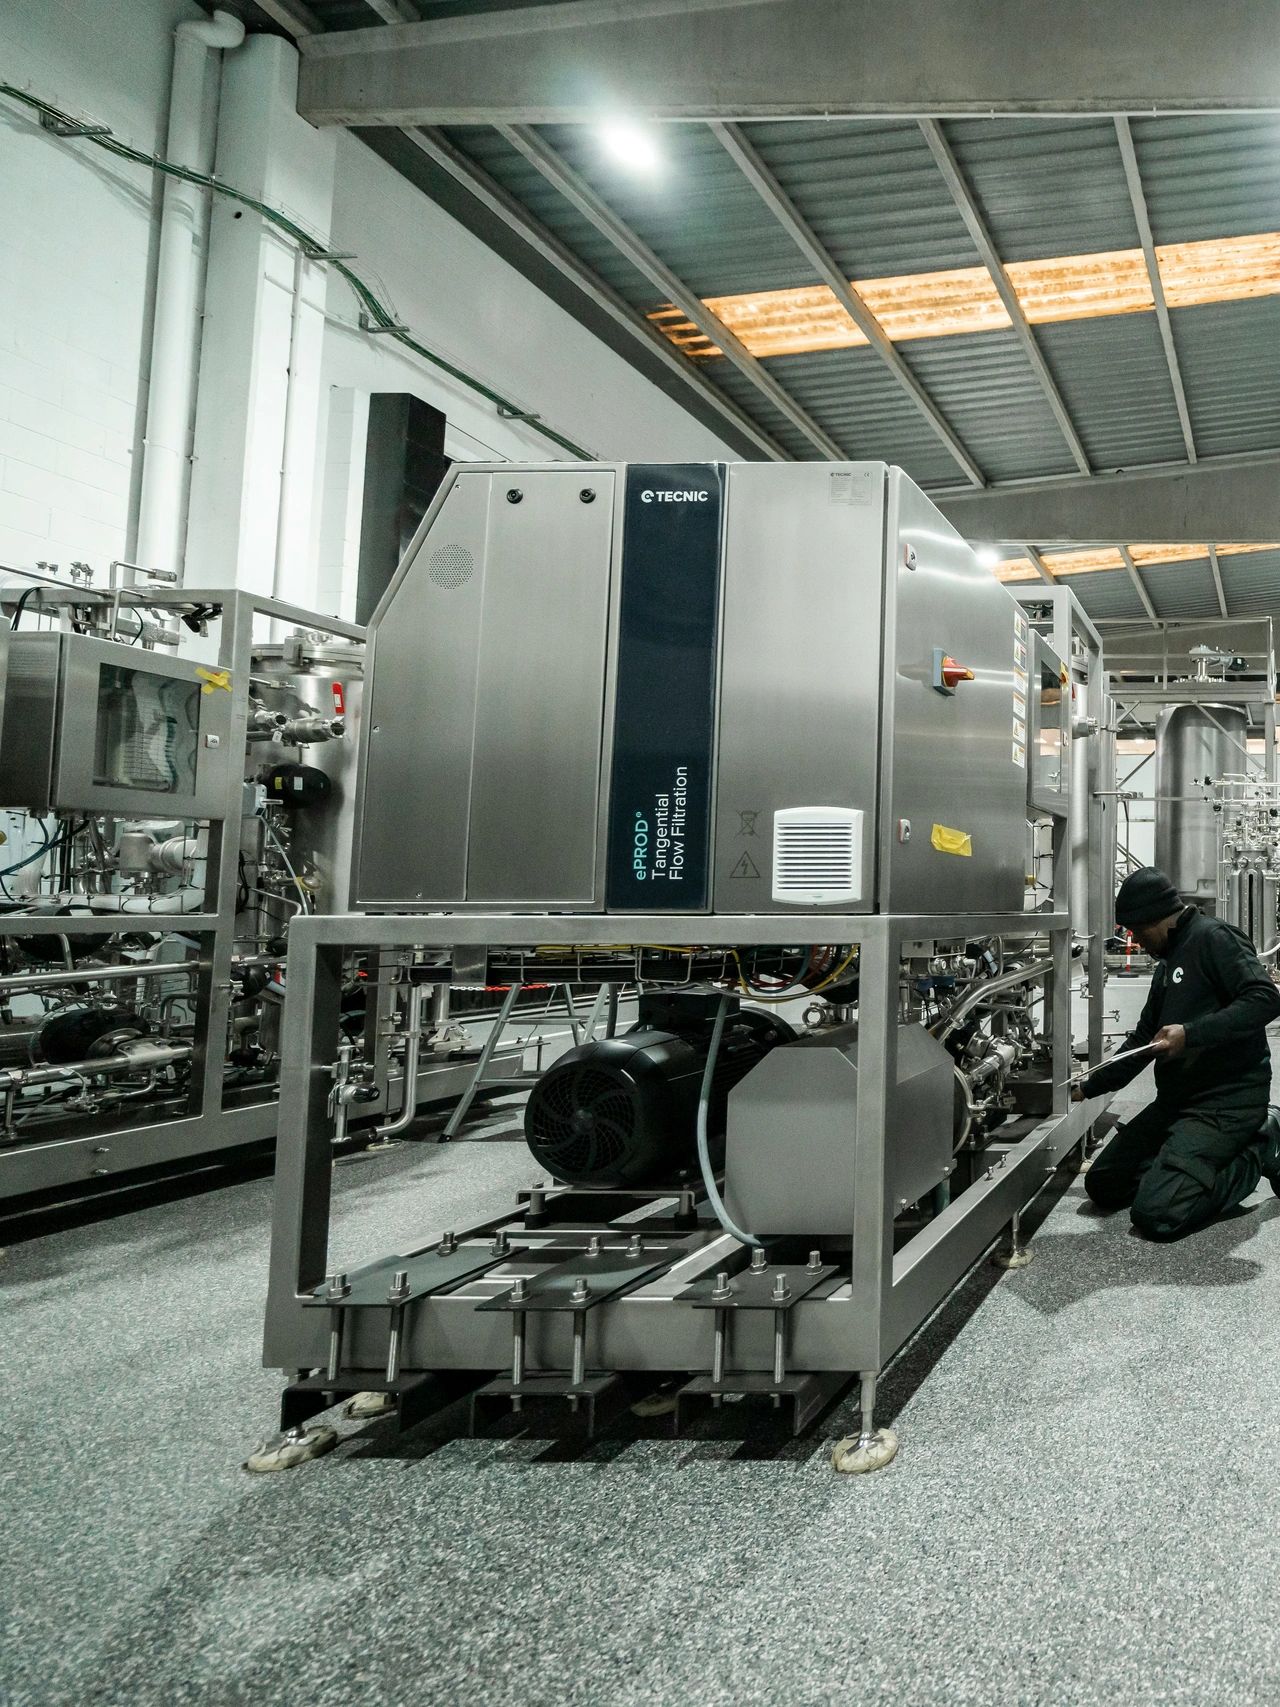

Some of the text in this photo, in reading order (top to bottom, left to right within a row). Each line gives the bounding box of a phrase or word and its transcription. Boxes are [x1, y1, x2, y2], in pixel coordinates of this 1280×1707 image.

[656, 491, 708, 502] TECNIC
[651, 793, 671, 881] Tangential
[669, 766, 688, 880] Flow Filtration
